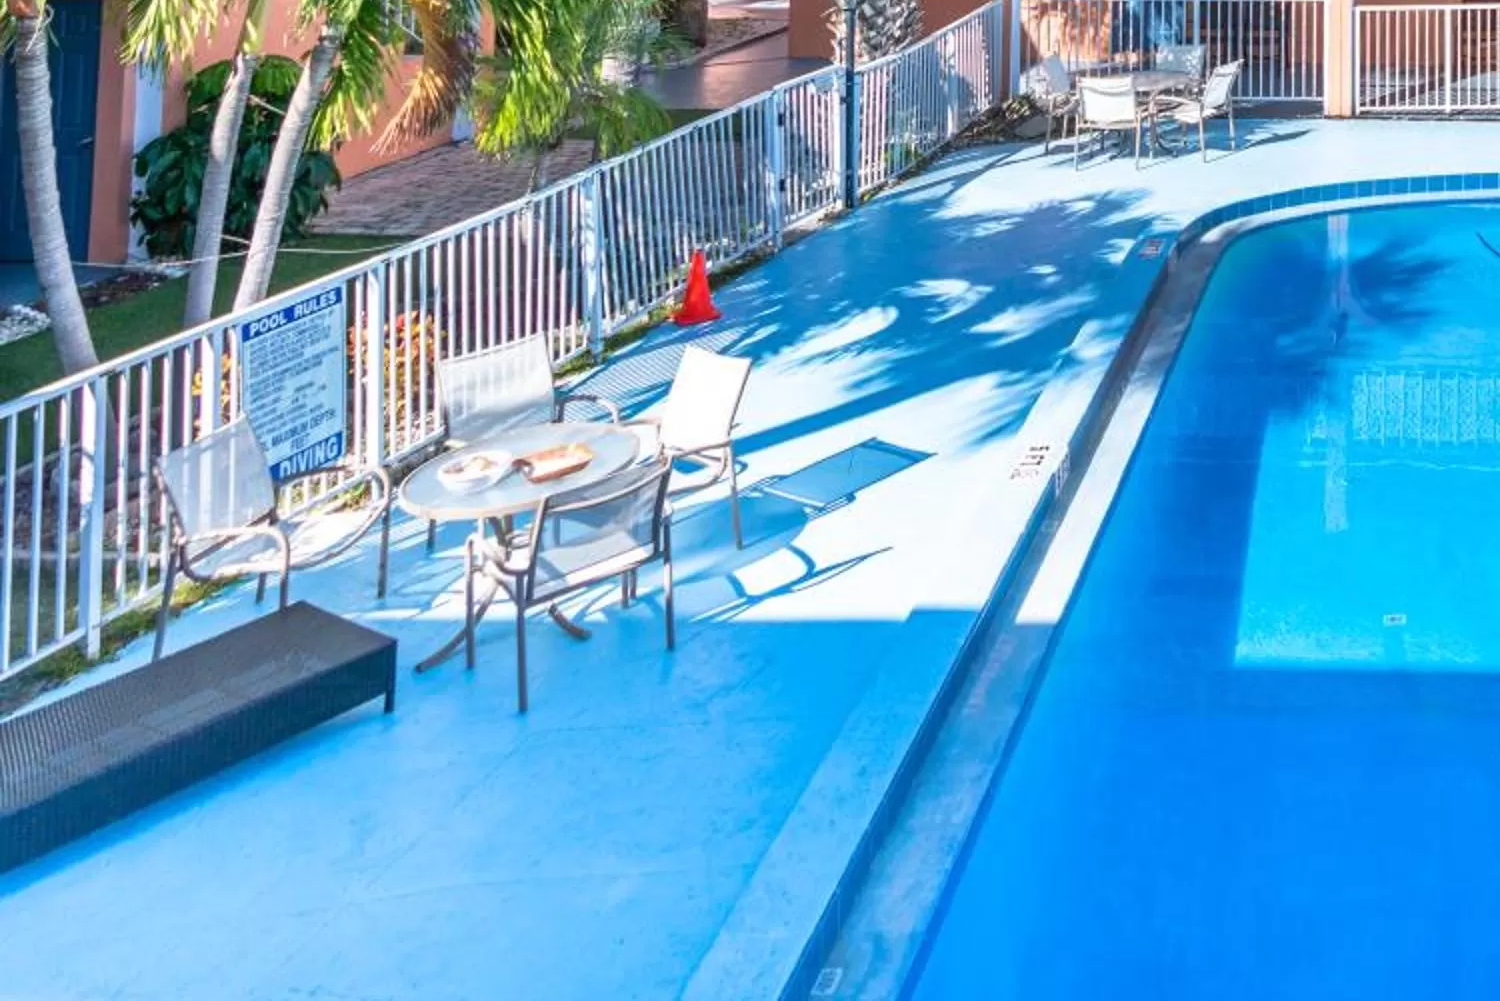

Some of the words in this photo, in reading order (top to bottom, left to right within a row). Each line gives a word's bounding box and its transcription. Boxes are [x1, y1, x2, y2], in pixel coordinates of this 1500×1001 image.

[249, 312, 288, 337] POOL
[295, 289, 337, 317] RULES
[280, 436, 339, 479] DIVING
